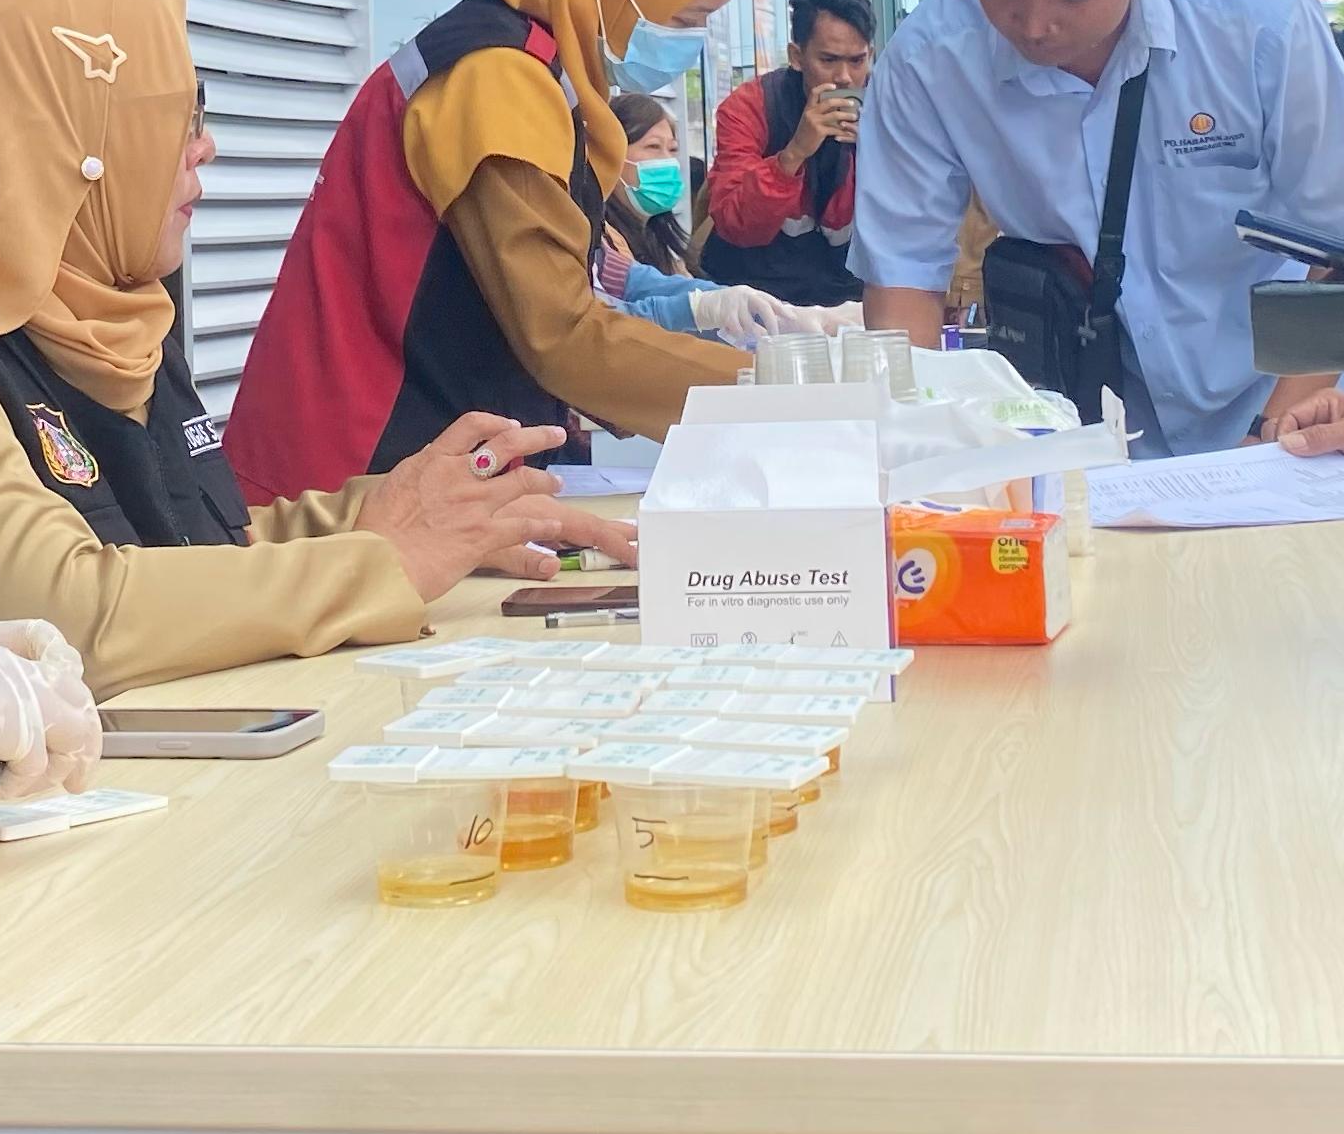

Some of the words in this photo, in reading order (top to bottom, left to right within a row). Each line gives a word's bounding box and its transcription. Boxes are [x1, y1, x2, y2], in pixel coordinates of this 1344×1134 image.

[688, 571, 734, 591] Drug
[739, 570, 801, 586] Abuse
[808, 569, 849, 585] Test
[687, 597, 706, 607] For
[709, 597, 718, 607] in
[721, 596, 744, 607] vitro
[747, 595, 802, 609] diagnostic
[805, 597, 824, 606] use
[826, 595, 849, 608] only
[464, 814, 494, 849] 10
[631, 816, 667, 849] 5
